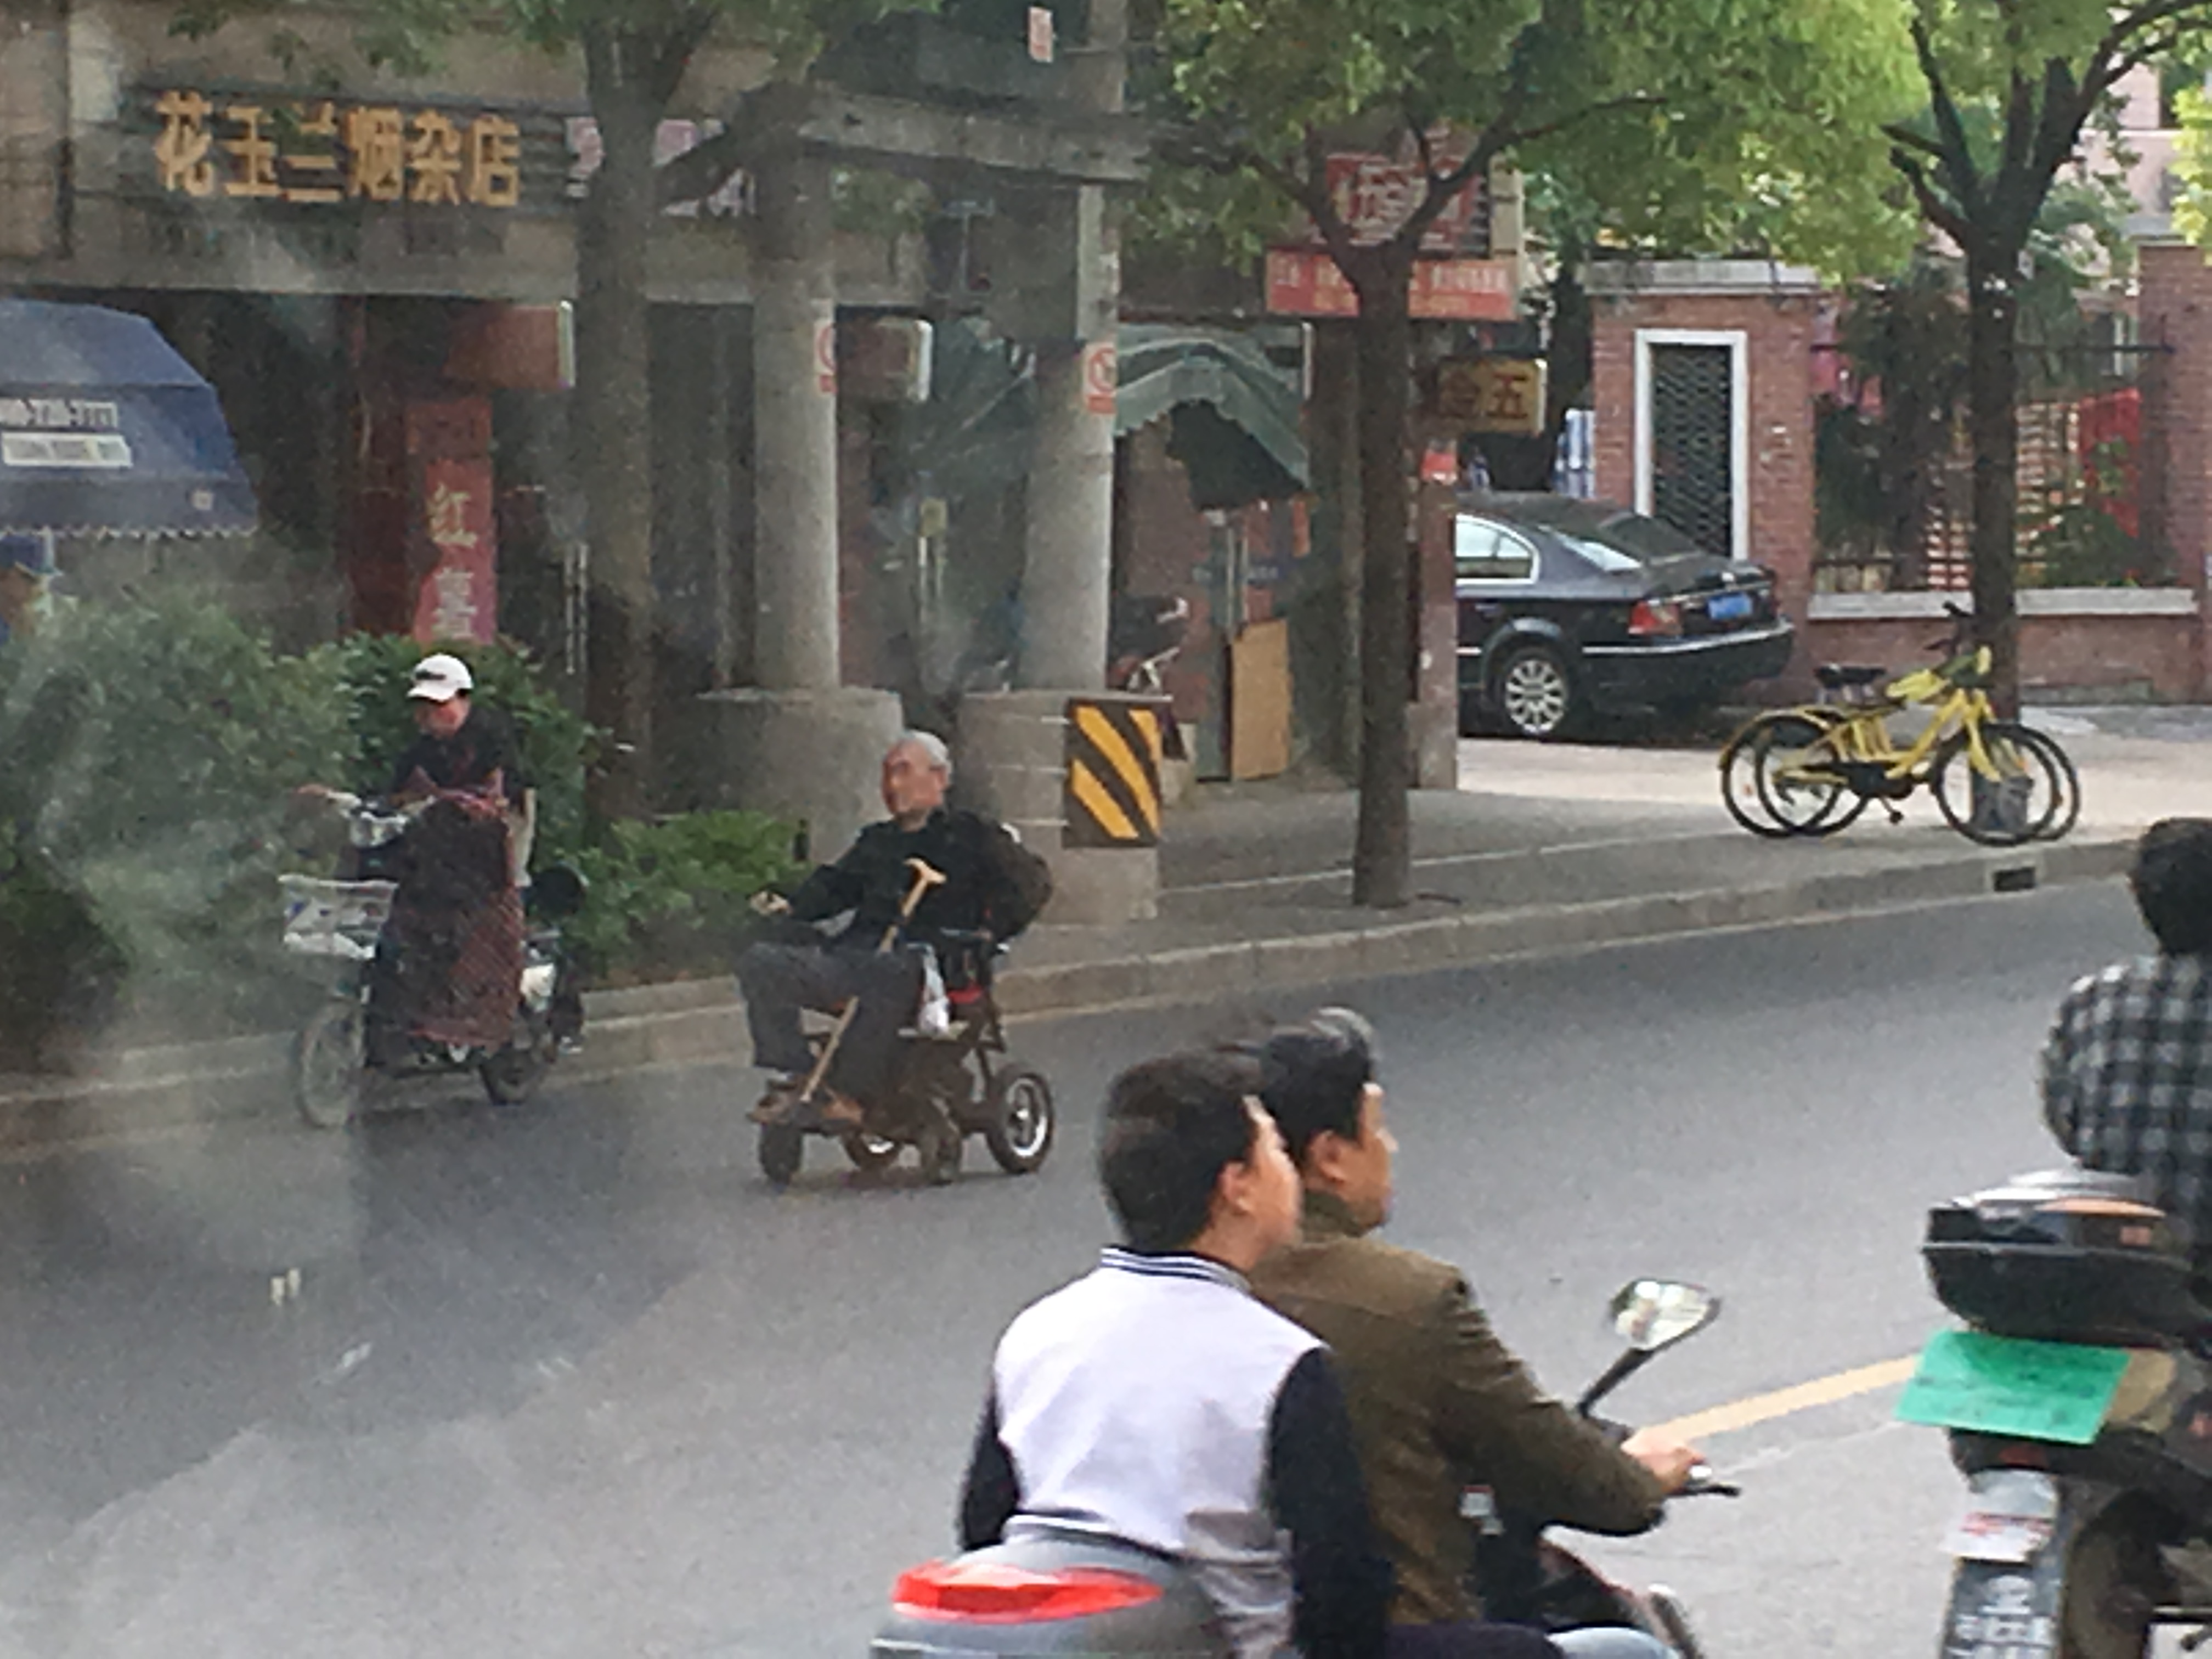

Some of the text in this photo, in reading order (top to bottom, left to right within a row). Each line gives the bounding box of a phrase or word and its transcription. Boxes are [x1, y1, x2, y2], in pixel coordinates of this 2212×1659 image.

[154, 90, 521, 207] 花玉兰烟杂店
